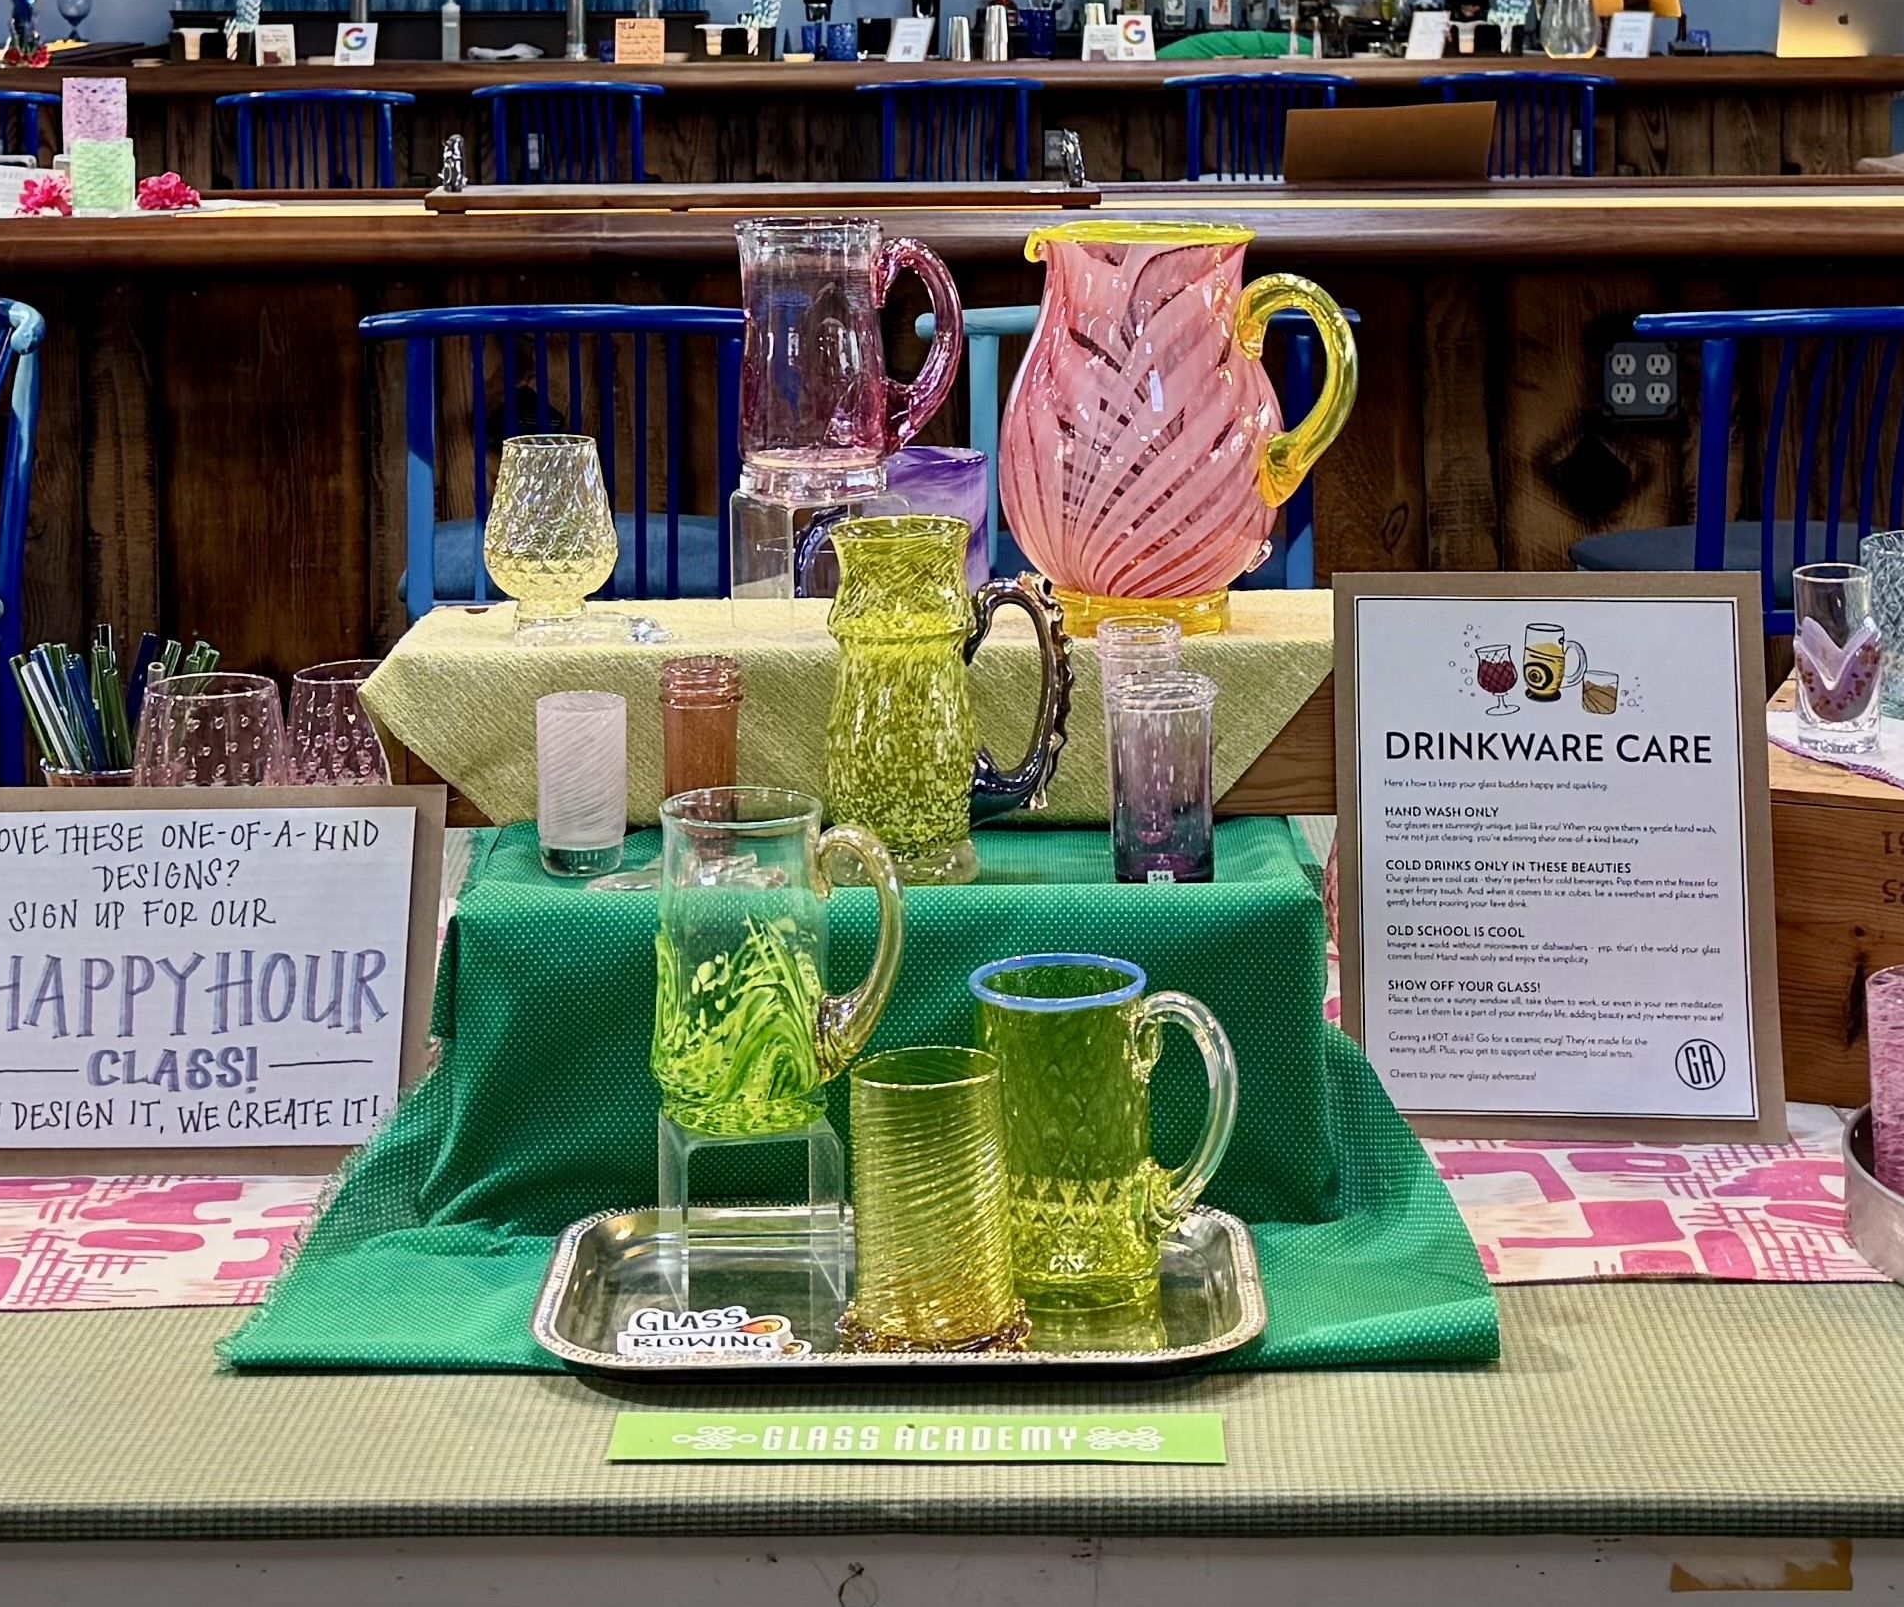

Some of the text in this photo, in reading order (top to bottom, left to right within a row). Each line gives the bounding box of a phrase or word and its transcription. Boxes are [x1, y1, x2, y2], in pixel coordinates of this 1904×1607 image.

[1385, 731, 1712, 764] DRINKWARE CARE
[1385, 779, 1408, 787] Here's
[1439, 780, 1456, 788] keep
[1478, 780, 1496, 790] glass
[1385, 807, 1499, 817] HAND WASH ONLY
[56, 823, 144, 855] THESE
[162, 820, 379, 852] ONE-OF-A-KIND
[94, 859, 240, 891] DESIGNS?
[1386, 860, 1631, 873] COLD DRINKS ONLY IN THESE BEAUTIES
[9, 898, 276, 931] SIGN UP FOR OUR
[1387, 925, 1524, 937] OLD SCHOOL IS COOL
[205, 949, 388, 1034] HOUR
[1388, 980, 1541, 993] SHOW OFF YOUR GLASS!
[86, 1047, 259, 1092] CLASS!
[1685, 1045, 1716, 1084] GA
[14, 1099, 113, 1131] DESIGN
[129, 1099, 164, 1134] IT,
[177, 1105, 221, 1133] WE
[228, 1099, 332, 1129] CREATE
[342, 1096, 380, 1128] IT!
[636, 1308, 742, 1331] GLASS
[634, 1336, 771, 1348] BLOWING
[762, 1426, 1078, 1452] GLASS ACADEMY
